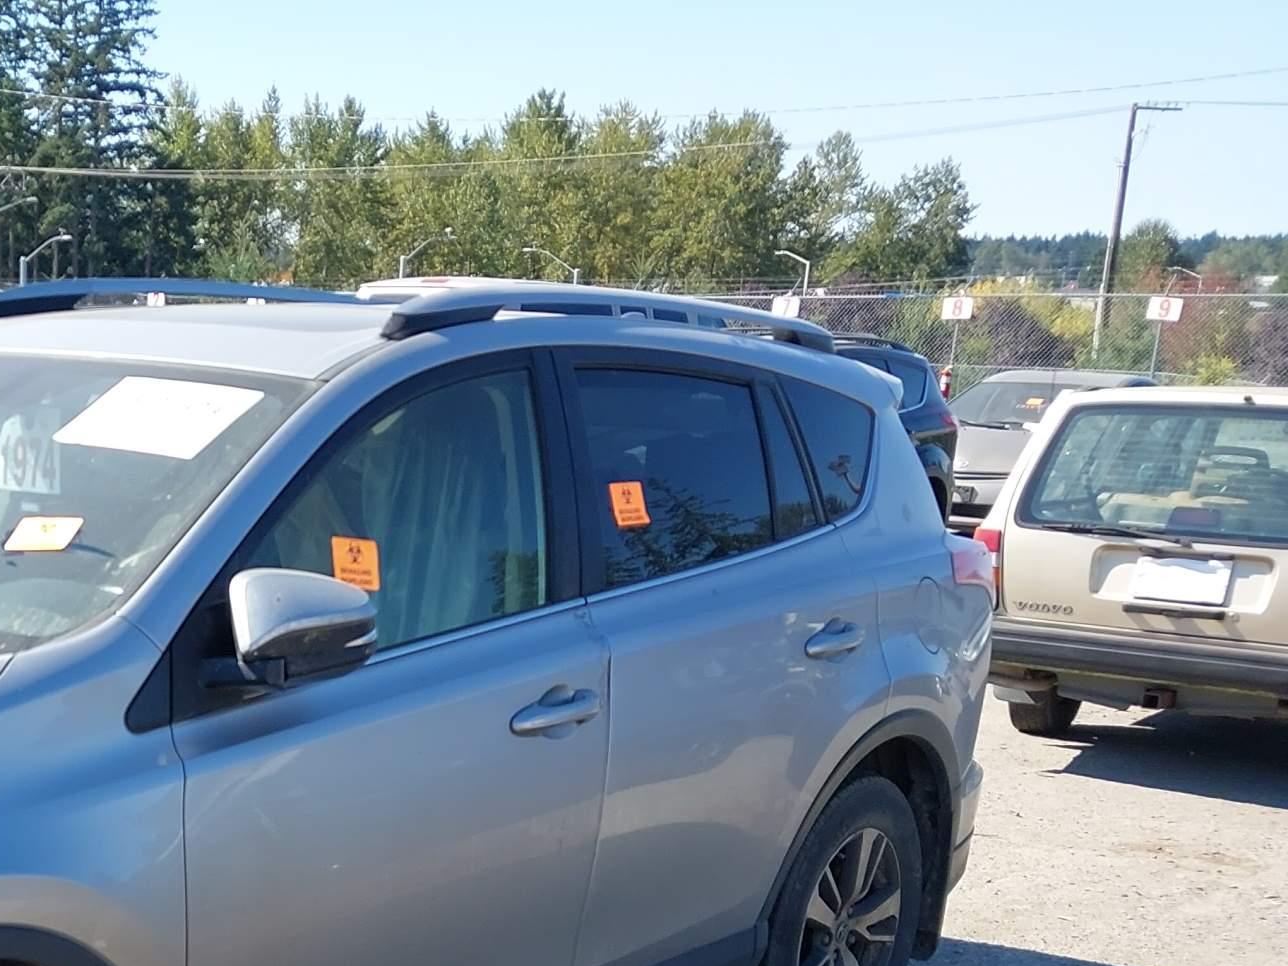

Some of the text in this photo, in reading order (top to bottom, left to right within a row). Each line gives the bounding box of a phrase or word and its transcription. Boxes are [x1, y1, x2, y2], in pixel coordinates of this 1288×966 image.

[952, 299, 963, 317] 8
[1158, 299, 1171, 318] 9
[1012, 600, 1074, 615] VOLVO
